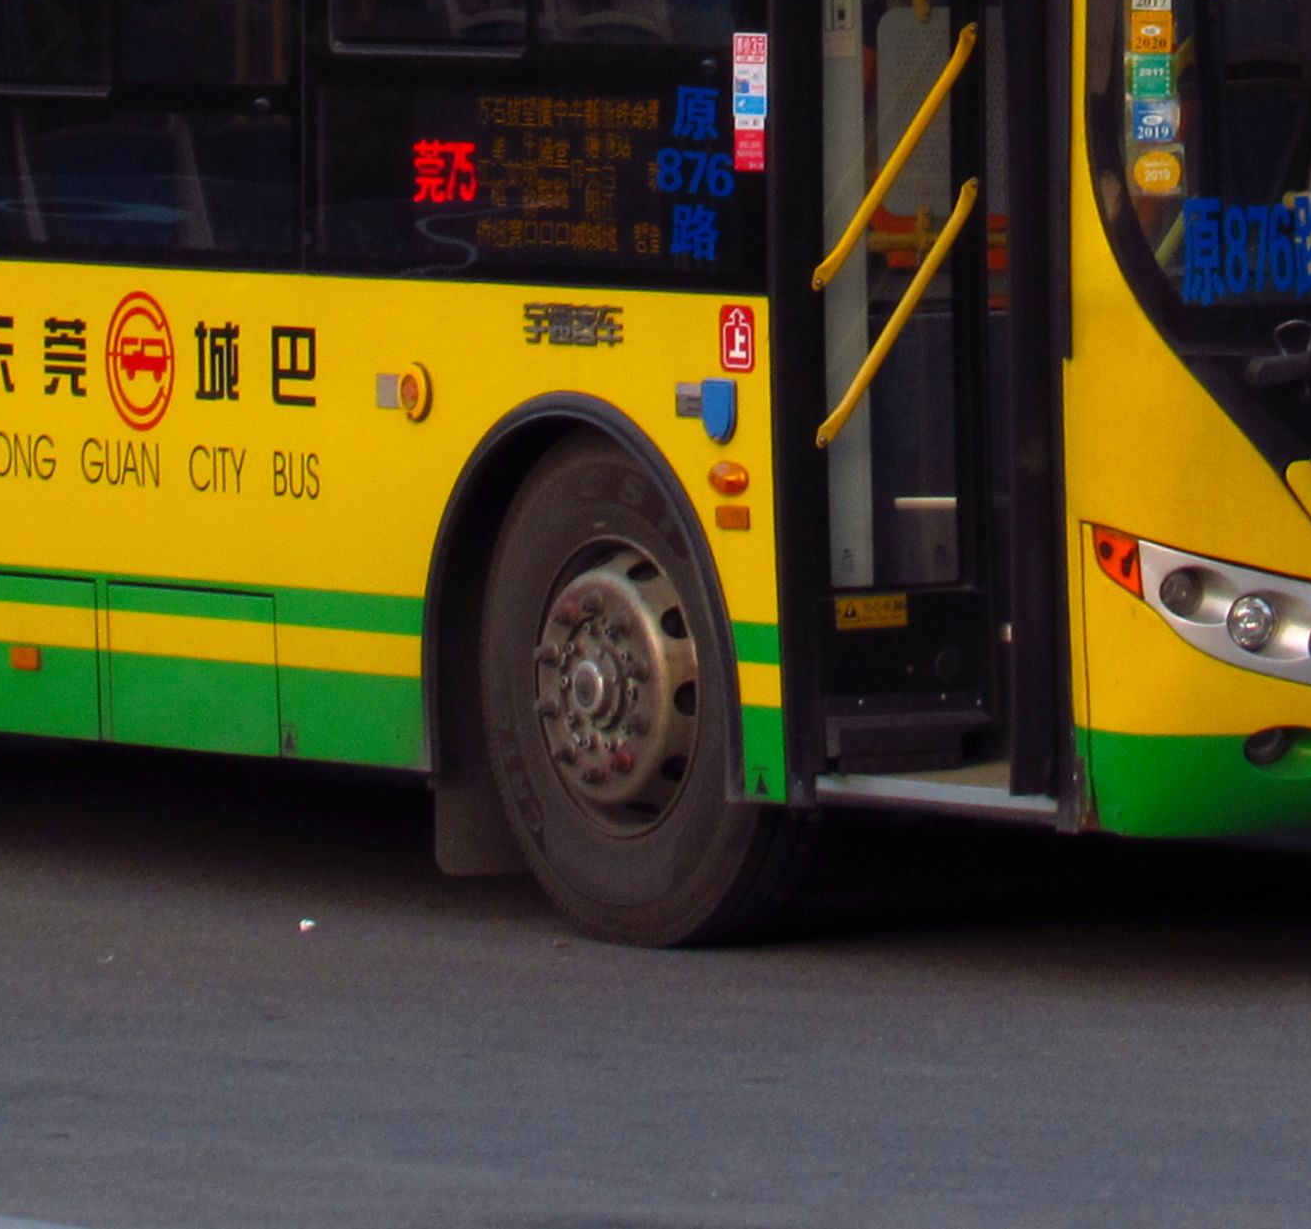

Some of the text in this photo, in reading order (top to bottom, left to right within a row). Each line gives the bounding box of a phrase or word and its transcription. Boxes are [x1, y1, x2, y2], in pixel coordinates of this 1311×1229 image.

[1135, 37, 1168, 50] 2020
[1138, 67, 1165, 77] 2017
[1136, 126, 1170, 139] 2019
[728, 329, 747, 360] 上
[194, 320, 318, 407] 城巴
[81, 437, 161, 489] GUAN
[189, 444, 247, 495] CITY
[273, 450, 321, 500] BUS
